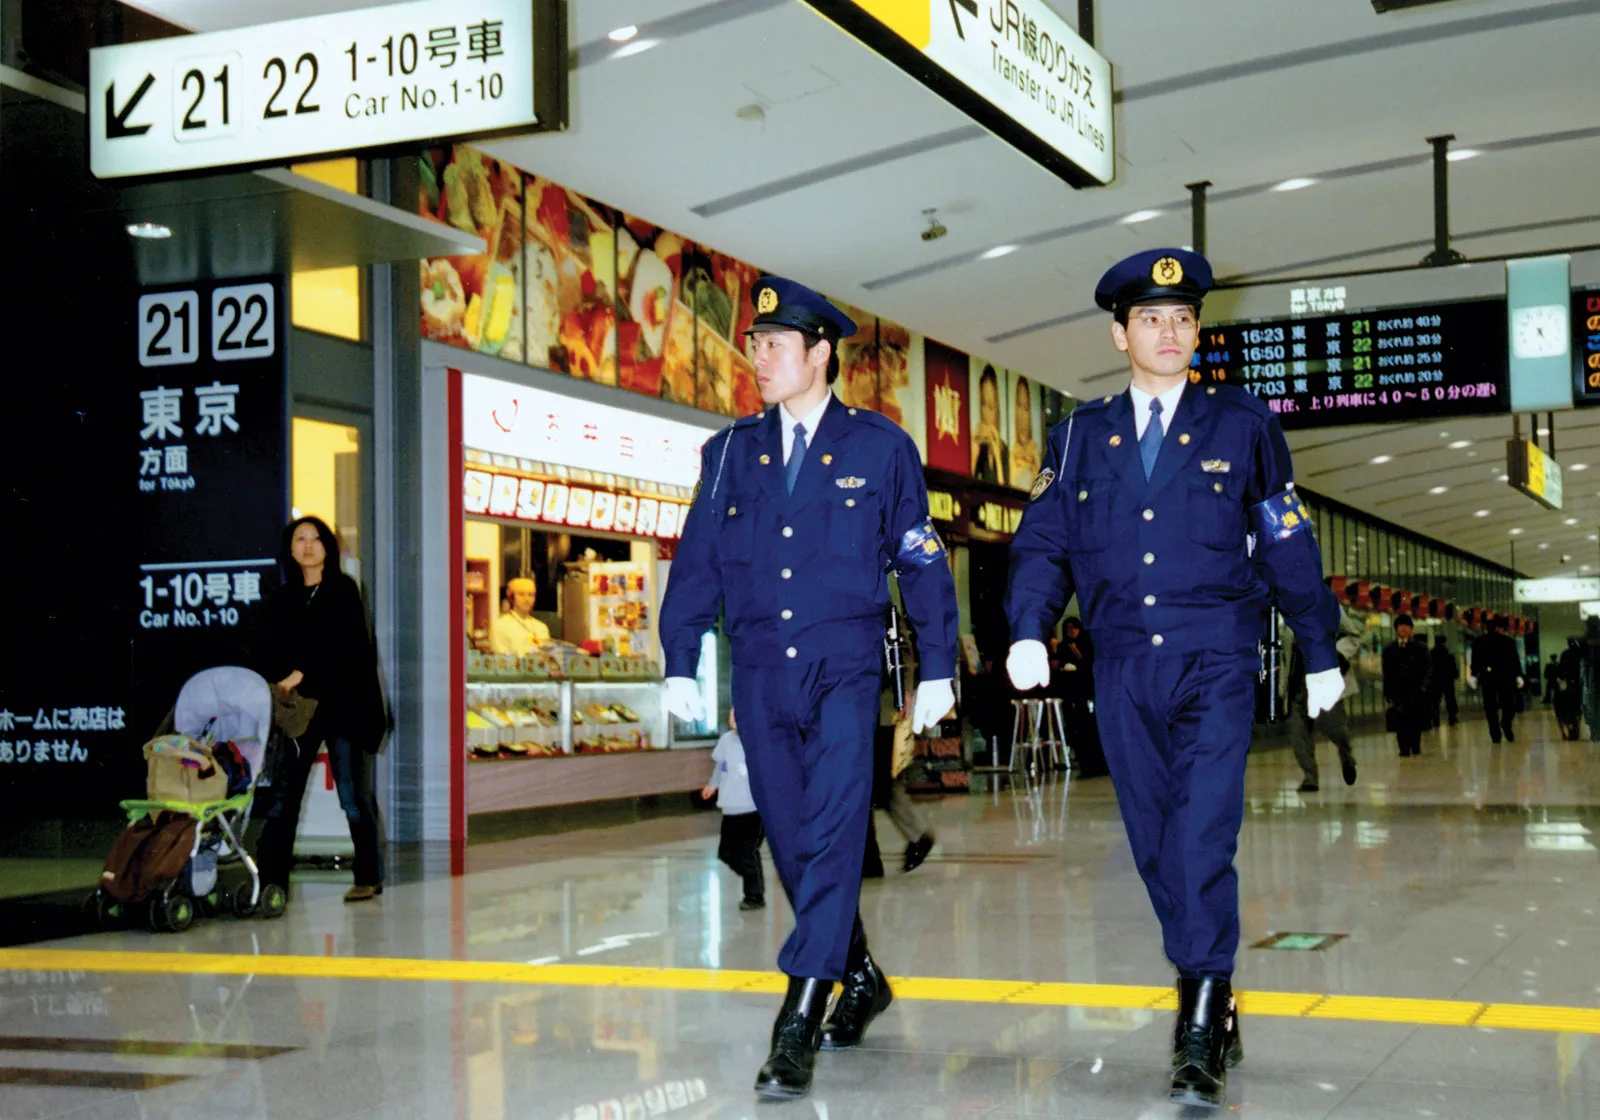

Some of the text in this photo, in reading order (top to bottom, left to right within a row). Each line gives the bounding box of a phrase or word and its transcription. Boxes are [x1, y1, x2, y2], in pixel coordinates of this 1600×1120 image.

[990, 0, 1095, 109] JR線のりかえ
[181, 18, 504, 130] 21 22 1-10号車
[344, 93, 389, 118] Car
[991, 40, 1104, 151] Transfer to JR Lines
[146, 294, 268, 356] 21 22
[1241, 327, 1285, 344] 16:23
[1352, 319, 1371, 334] 21
[1242, 345, 1285, 362] 16:50
[1352, 337, 1372, 352] 22
[1242, 362, 1286, 379] 17:00
[1353, 355, 1372, 371] 21
[1243, 380, 1287, 397] 17:03
[1354, 373, 1374, 389] 22
[139, 381, 240, 440] 東京
[139, 445, 188, 475] 方面
[138, 478, 156, 492] for
[139, 570, 262, 608] 1-10号車
[139, 610, 169, 628] Car
[0, 706, 126, 731] ホームに売店は
[0, 739, 88, 763] ありません
